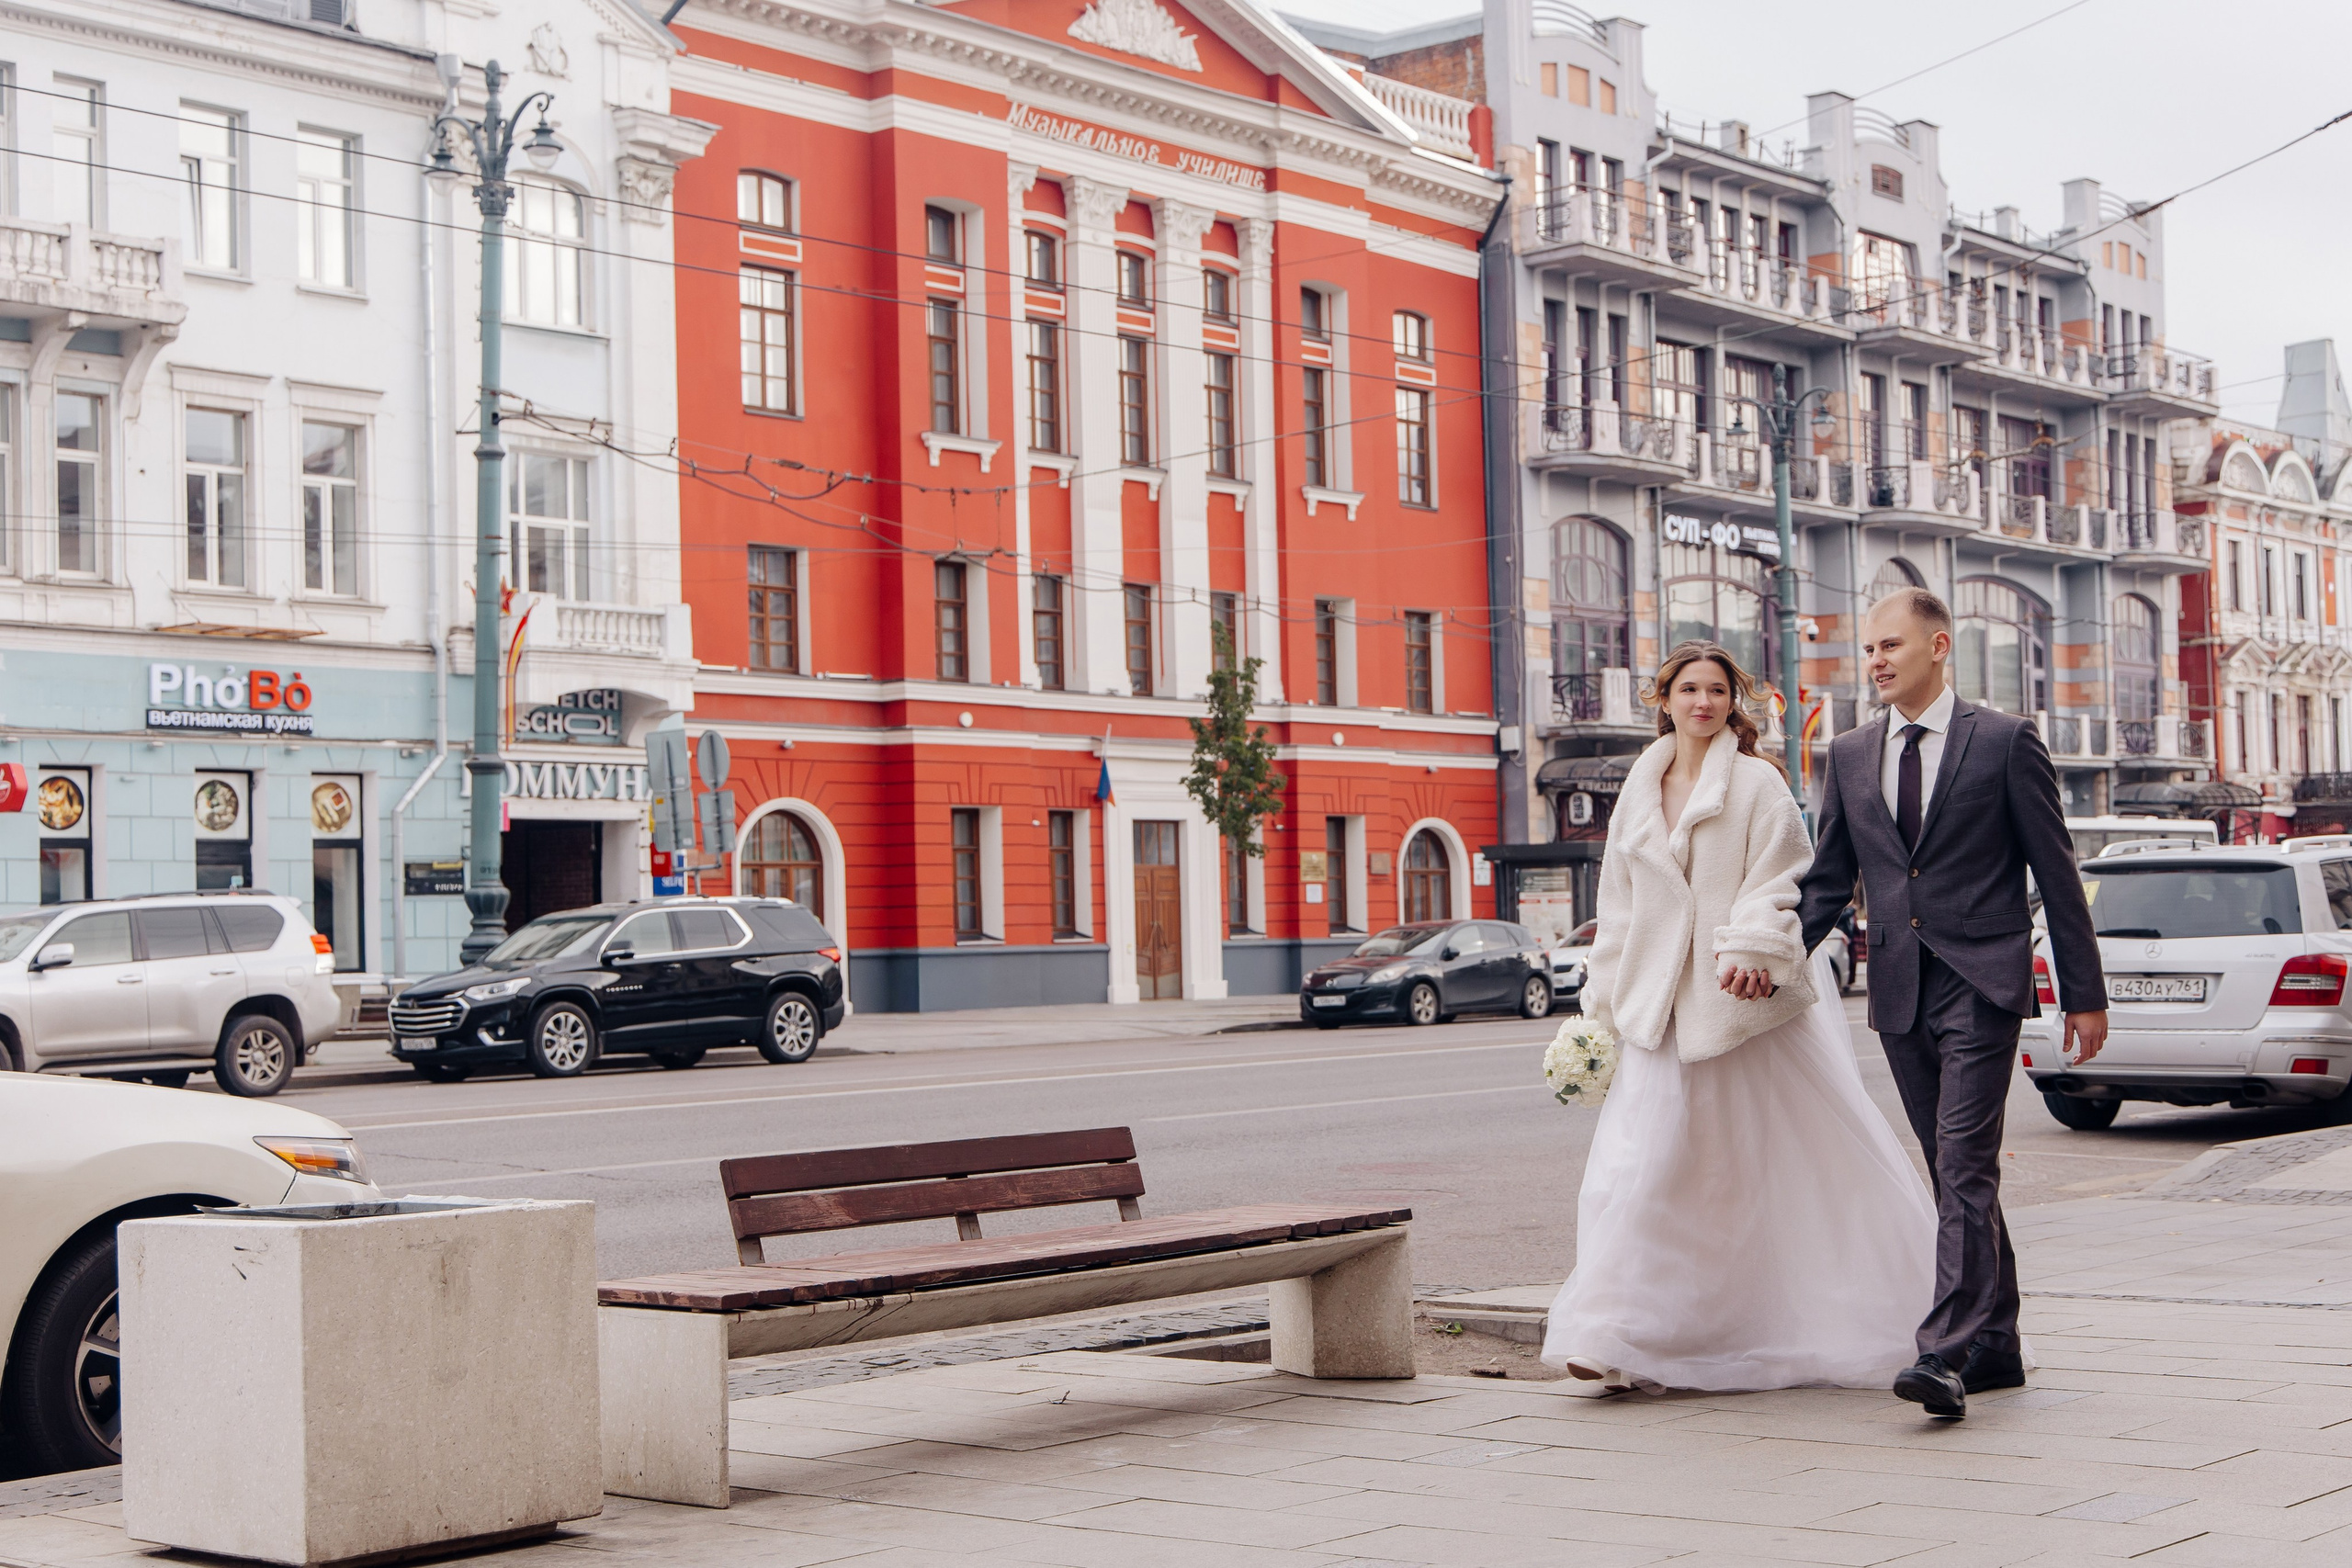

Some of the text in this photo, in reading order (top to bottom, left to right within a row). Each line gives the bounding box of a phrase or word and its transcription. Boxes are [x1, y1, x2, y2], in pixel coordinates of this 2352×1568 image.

[560, 689, 618, 710] ETCH
[148, 710, 313, 734] вьетнамская кухня
[460, 760, 652, 801] ОММУН
